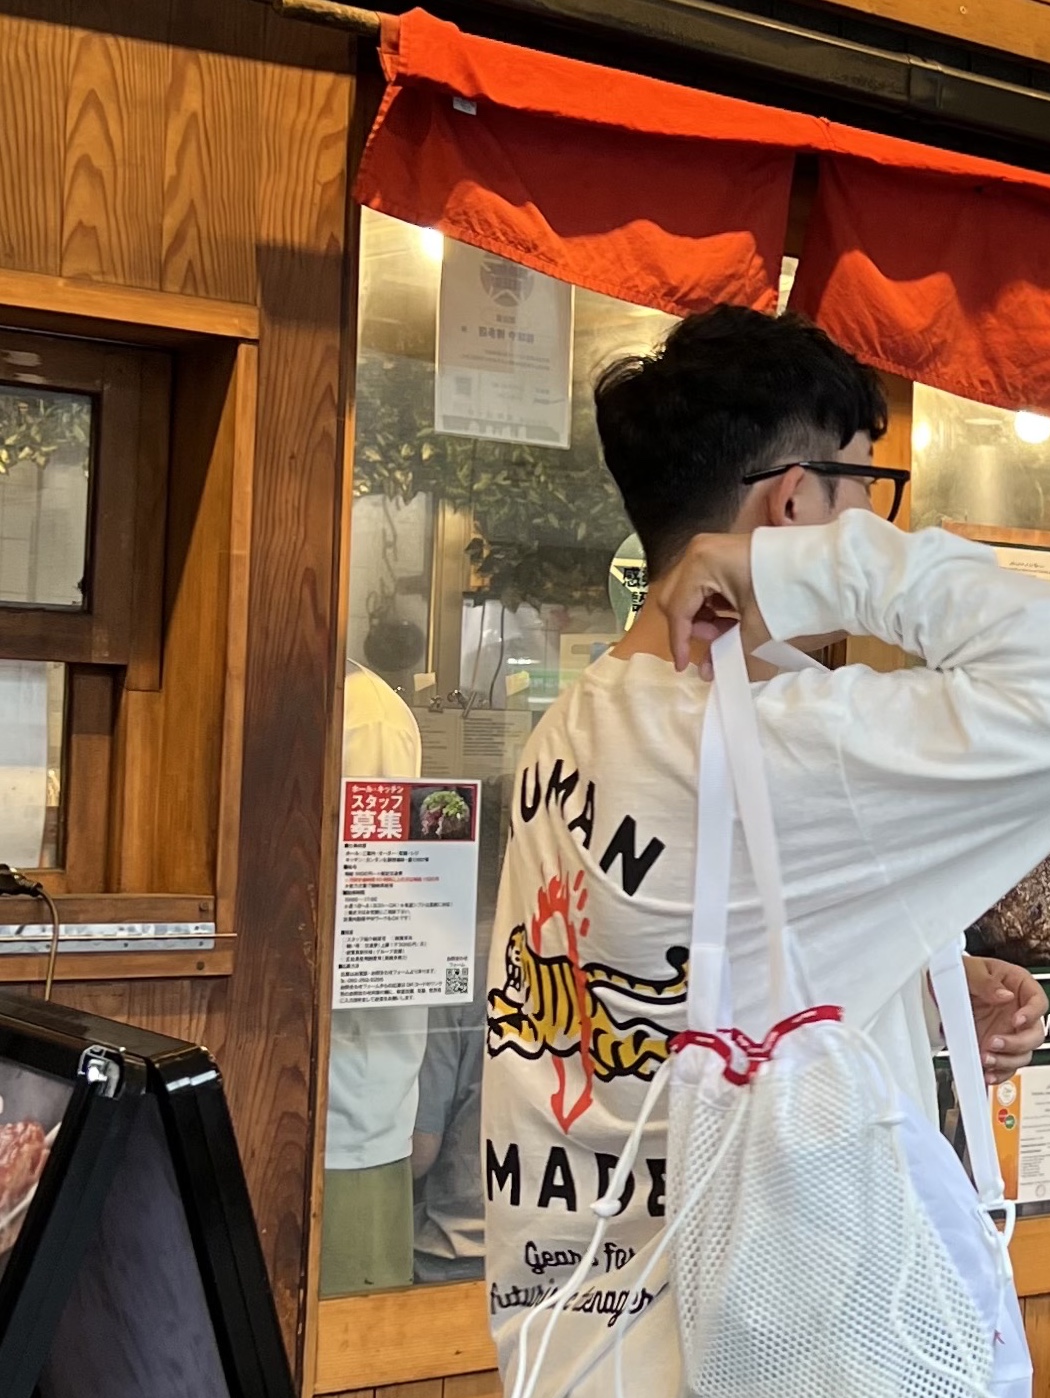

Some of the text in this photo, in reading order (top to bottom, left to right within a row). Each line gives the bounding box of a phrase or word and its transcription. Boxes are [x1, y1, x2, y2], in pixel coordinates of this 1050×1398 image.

[351, 795, 403, 810] スタッフ
[350, 810, 402, 839] 募集
